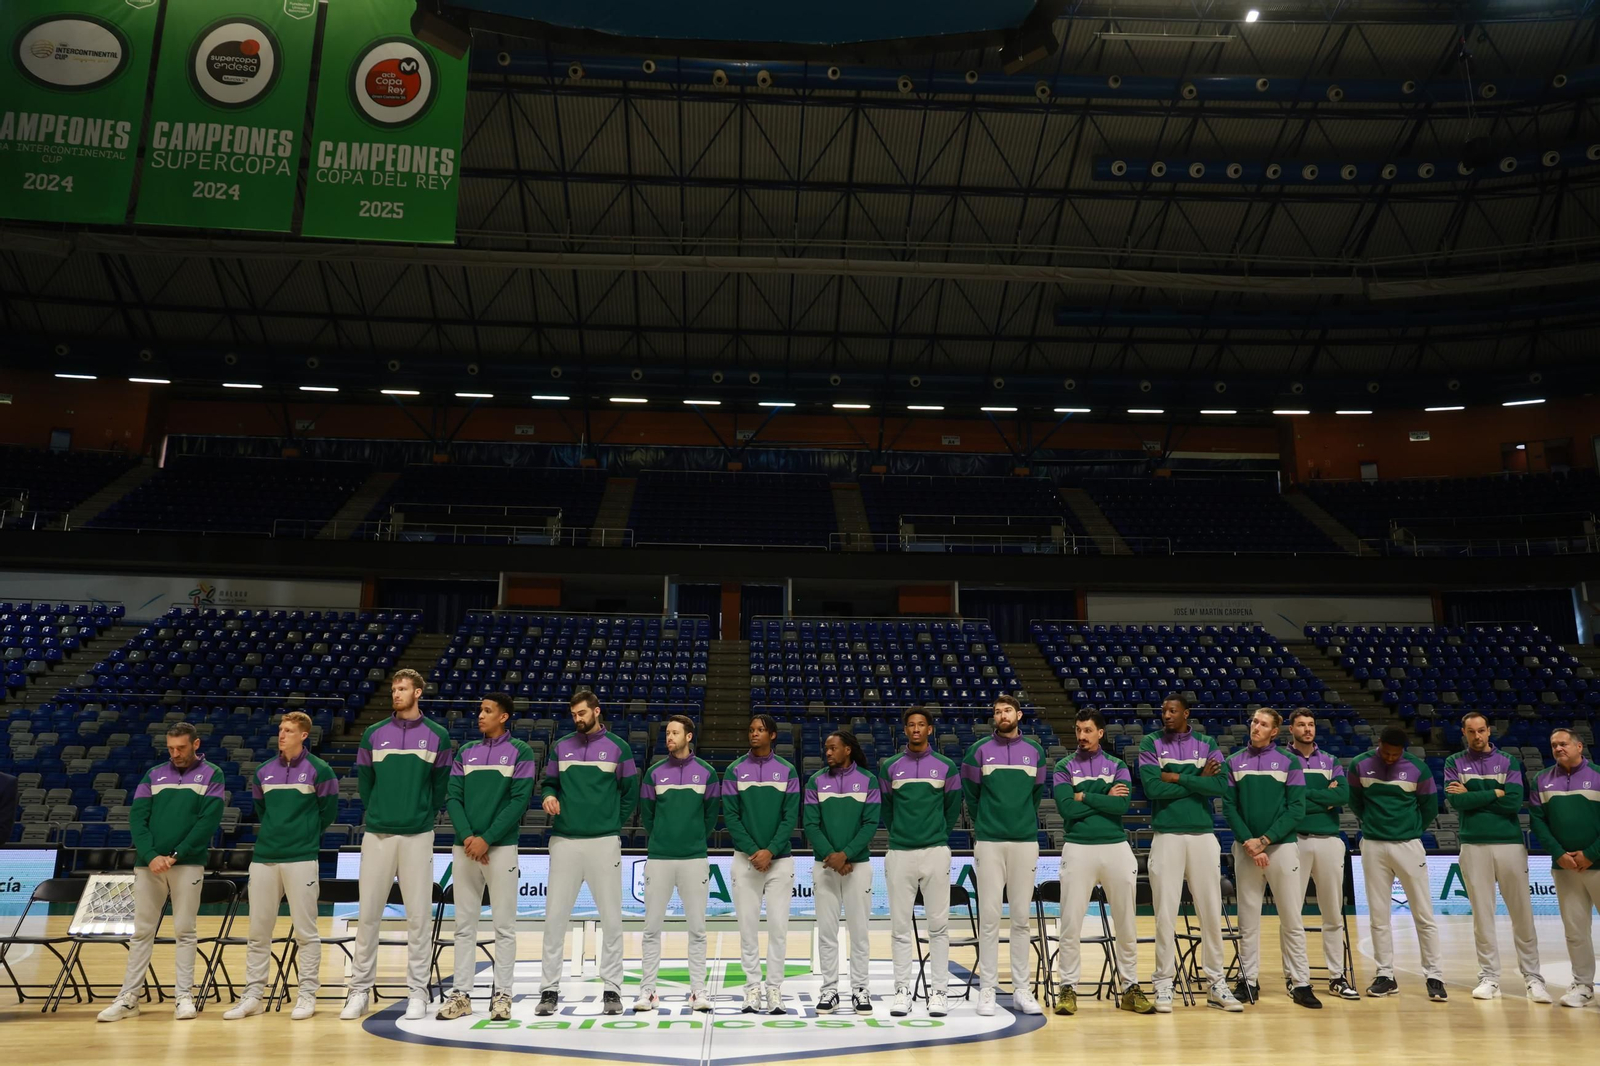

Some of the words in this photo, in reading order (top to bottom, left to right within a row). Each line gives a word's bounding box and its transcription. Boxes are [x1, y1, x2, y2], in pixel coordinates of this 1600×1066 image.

[56, 47, 118, 59] INTERCONTINENTAL
[210, 54, 257, 64] supercopa
[213, 61, 256, 72] endesa
[375, 77, 403, 86] Copa
[387, 85, 406, 95] Rey
[152, 121, 293, 158] CAMPEONES
[16, 143, 126, 160] INTERCONTINENTAL
[317, 140, 455, 176] CAMPEONES
[41, 154, 63, 164] CUP
[151, 150, 291, 176] SUPERCOPA
[23, 173, 74, 192] 2024
[316, 168, 364, 185] COPA
[372, 171, 407, 187] DEL
[416, 174, 452, 190] REY
[192, 181, 241, 200] 2024
[359, 200, 405, 219] 2025
[1173, 607, 1187, 616] JOSÉ
[1199, 607, 1223, 616] MARTÍN
[1224, 608, 1254, 616] CARPENA
[470, 1018, 946, 1030] Baloncesto
